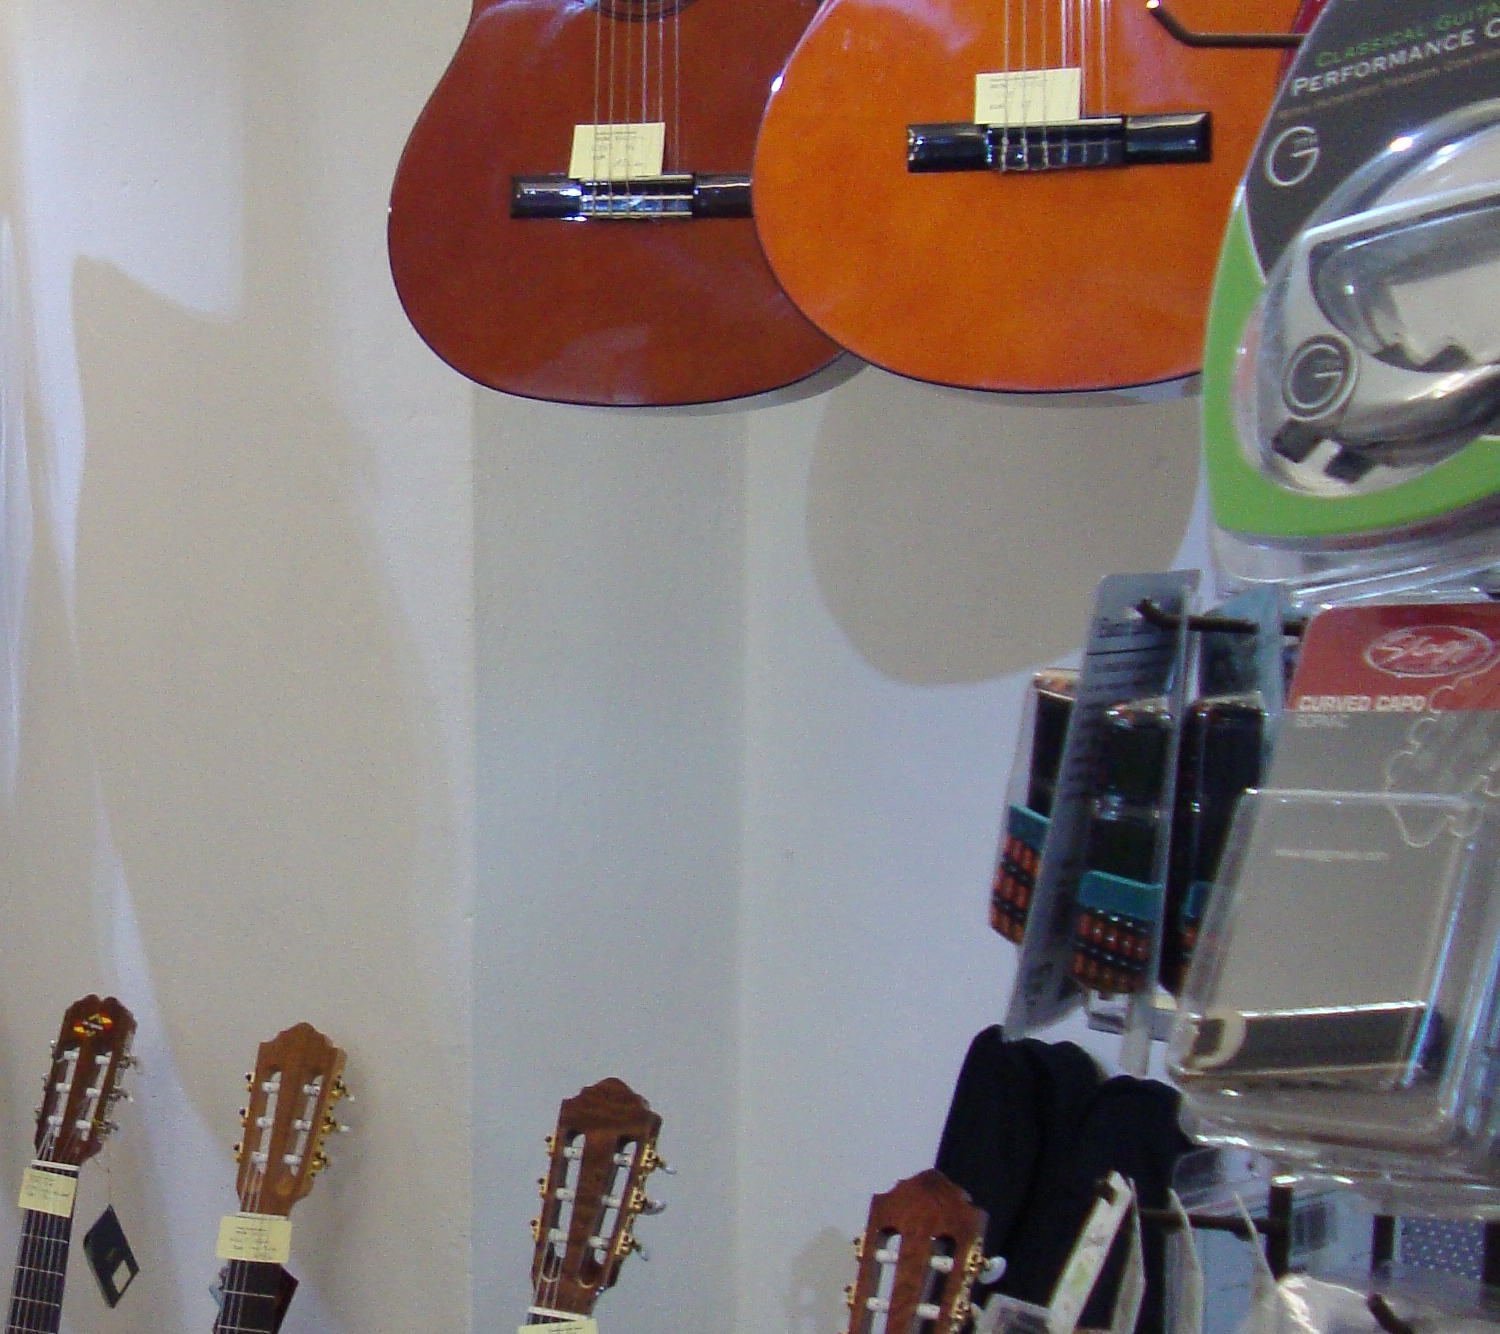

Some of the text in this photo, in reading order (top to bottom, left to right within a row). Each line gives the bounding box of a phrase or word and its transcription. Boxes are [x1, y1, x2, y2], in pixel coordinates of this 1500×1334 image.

[1290, 28, 1476, 97] PERFORMANCE
[1315, 28, 1427, 67] CLASSICAL
[1374, 694, 1427, 713] CAPO
